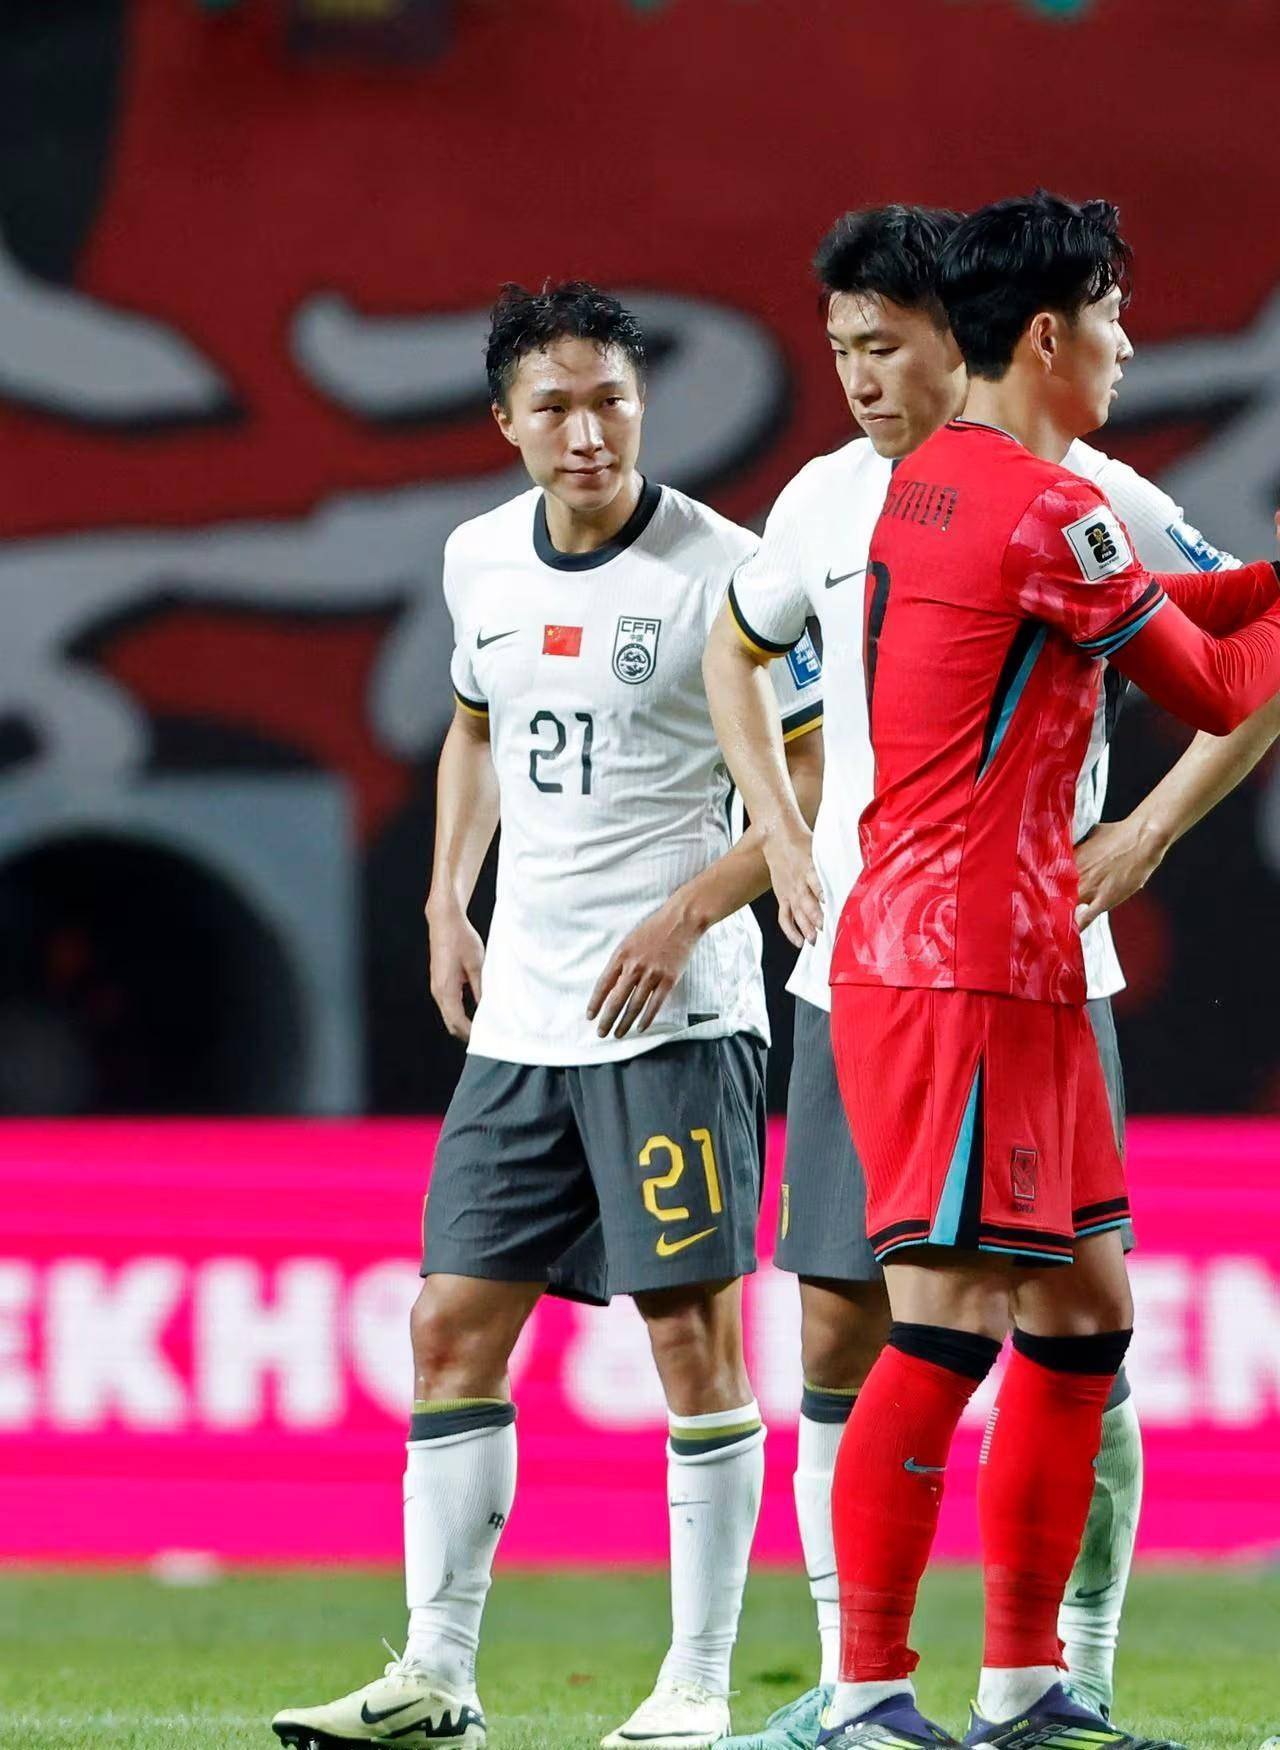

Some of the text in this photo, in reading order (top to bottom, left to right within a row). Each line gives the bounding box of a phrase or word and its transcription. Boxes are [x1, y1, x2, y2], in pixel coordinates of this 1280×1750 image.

[621, 621, 657, 635] CFA
[529, 710, 594, 795] 21
[638, 1128, 723, 1222] 21
